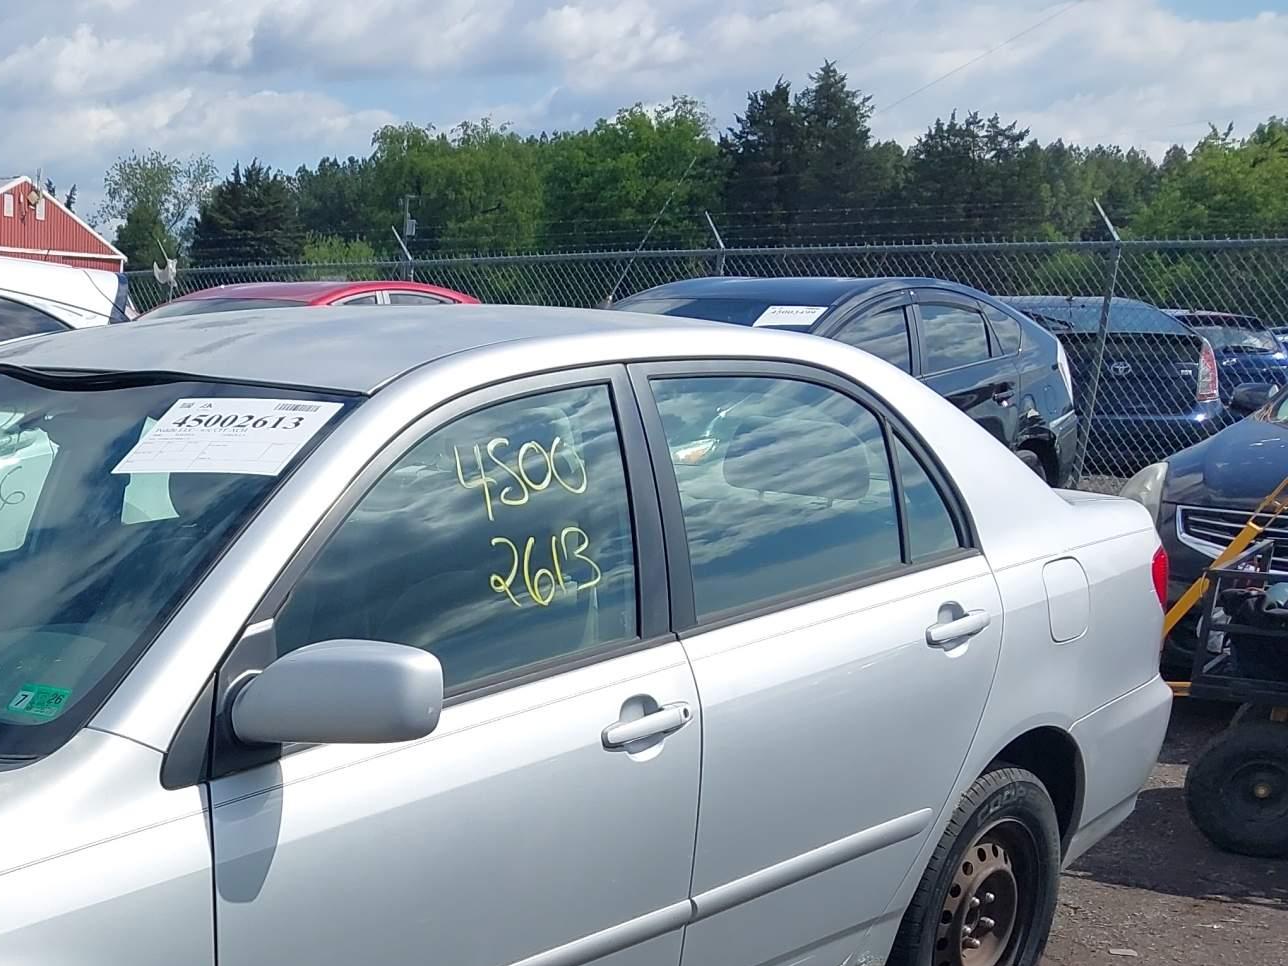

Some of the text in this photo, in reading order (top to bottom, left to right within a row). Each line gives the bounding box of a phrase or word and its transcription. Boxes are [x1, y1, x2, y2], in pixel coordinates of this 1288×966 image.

[172, 414, 305, 430] 45002613
[454, 436, 588, 521] 4500
[489, 526, 602, 608] 2613
[14, 693, 65, 706] 7 26
